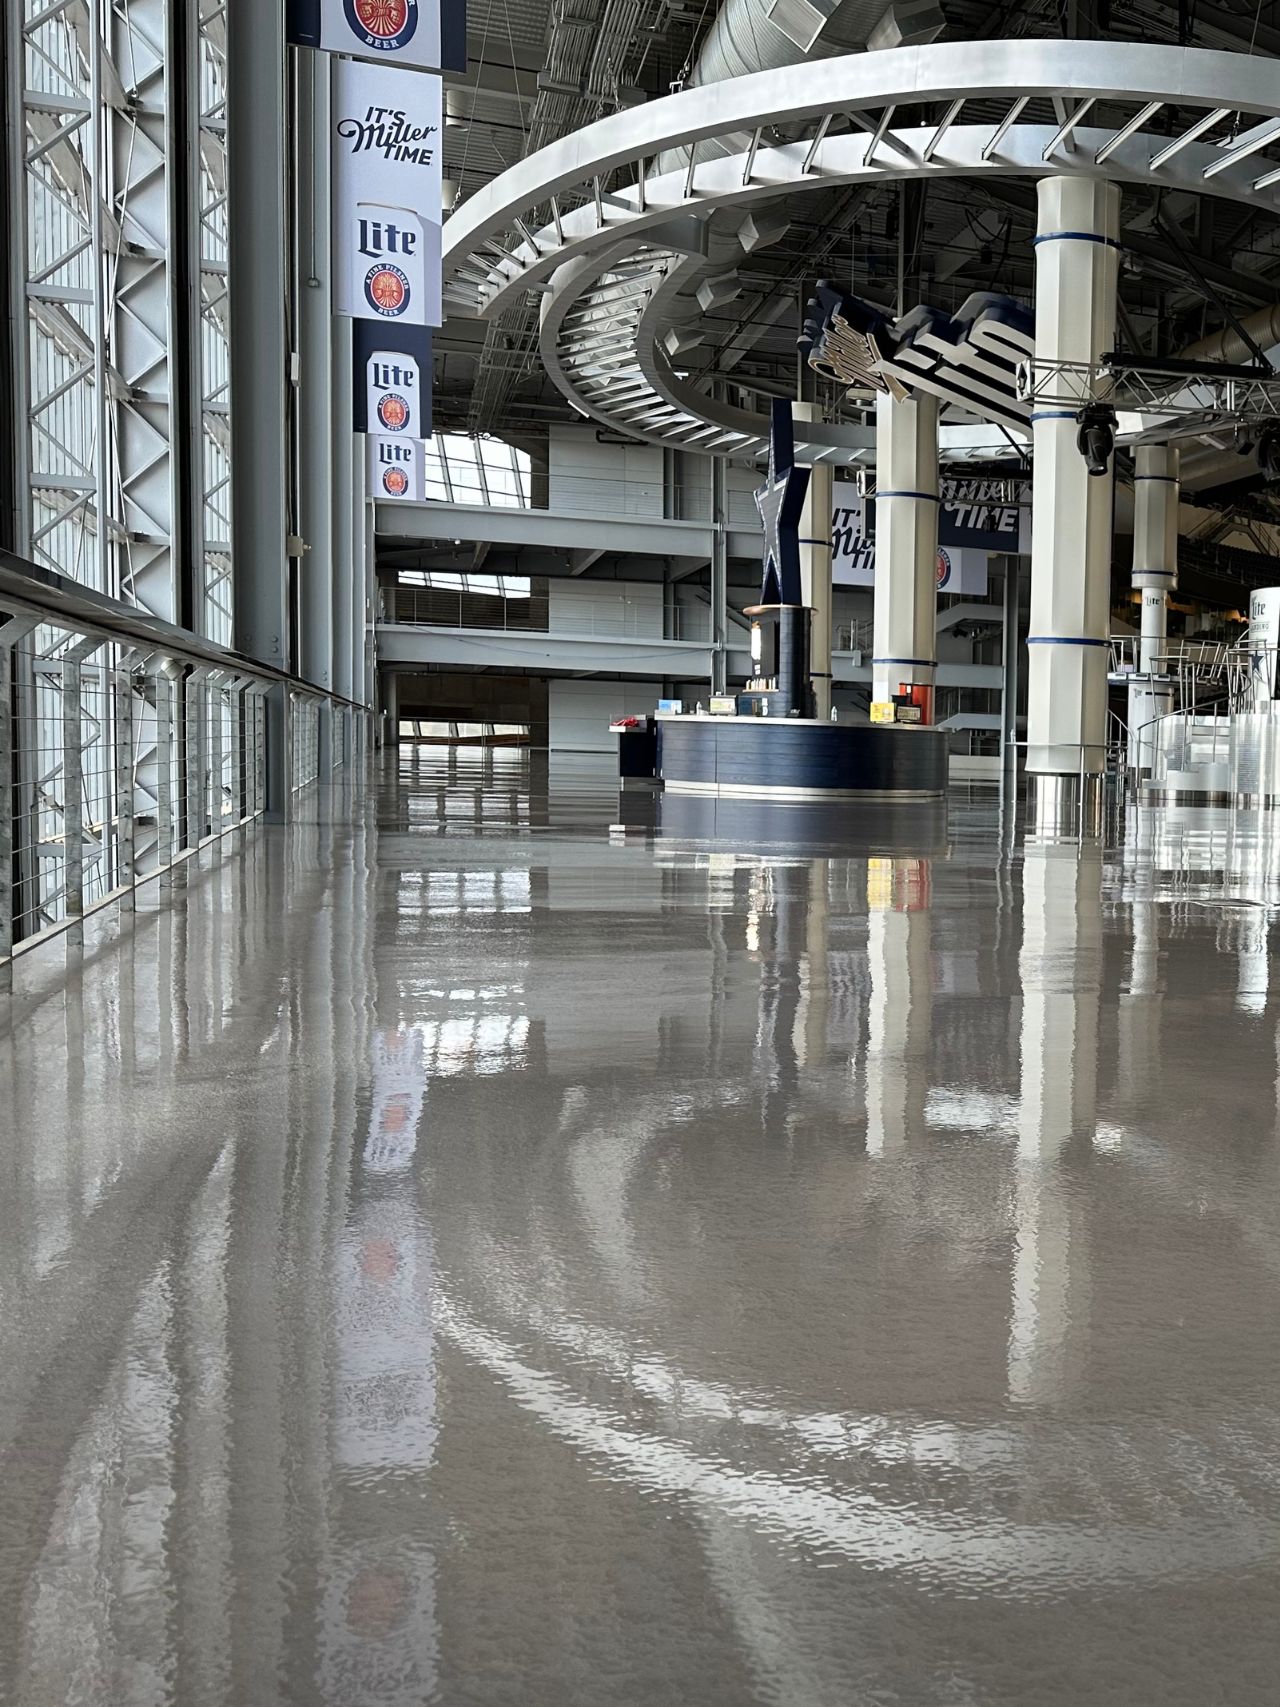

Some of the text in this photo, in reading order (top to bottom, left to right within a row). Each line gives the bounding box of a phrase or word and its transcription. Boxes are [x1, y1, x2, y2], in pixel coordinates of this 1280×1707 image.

[365, 34, 399, 49] BEER
[365, 106, 406, 127] IT'S
[337, 118, 437, 153] Miller
[384, 143, 433, 166] TIME
[357, 218, 416, 259] Lite
[377, 308, 399, 316] BEER
[372, 362, 414, 391] Lite
[379, 443, 411, 465] Lite
